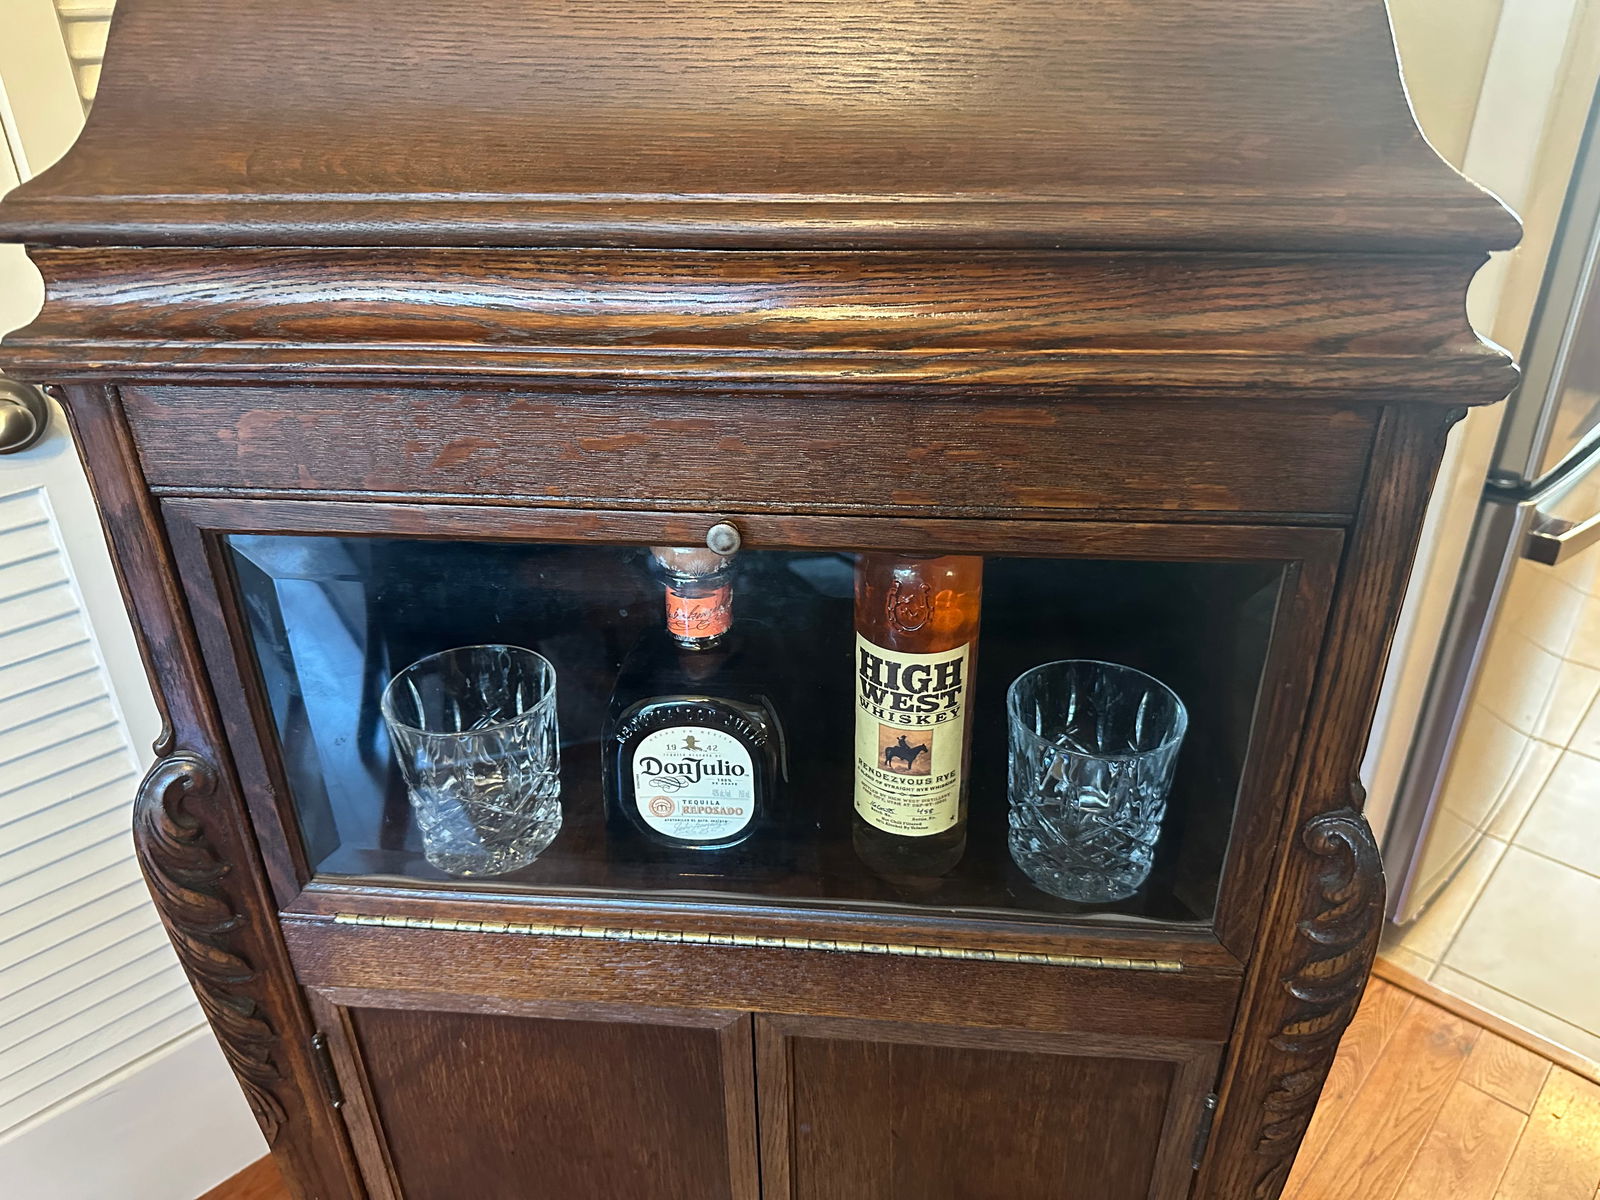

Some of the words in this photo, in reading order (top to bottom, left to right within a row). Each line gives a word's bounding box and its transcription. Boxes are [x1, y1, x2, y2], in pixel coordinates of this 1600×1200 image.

[860, 646, 964, 695] HIGH
[860, 677, 962, 713] WEST
[860, 697, 961, 725] WHISKEY
[666, 744, 678, 752] 19
[706, 744, 719, 752] 42
[858, 757, 932, 786] RENDEZVOUS
[936, 769, 957, 783] RYE
[884, 783, 915, 793] STRAIGHT
[682, 805, 744, 817] REPOSADO
